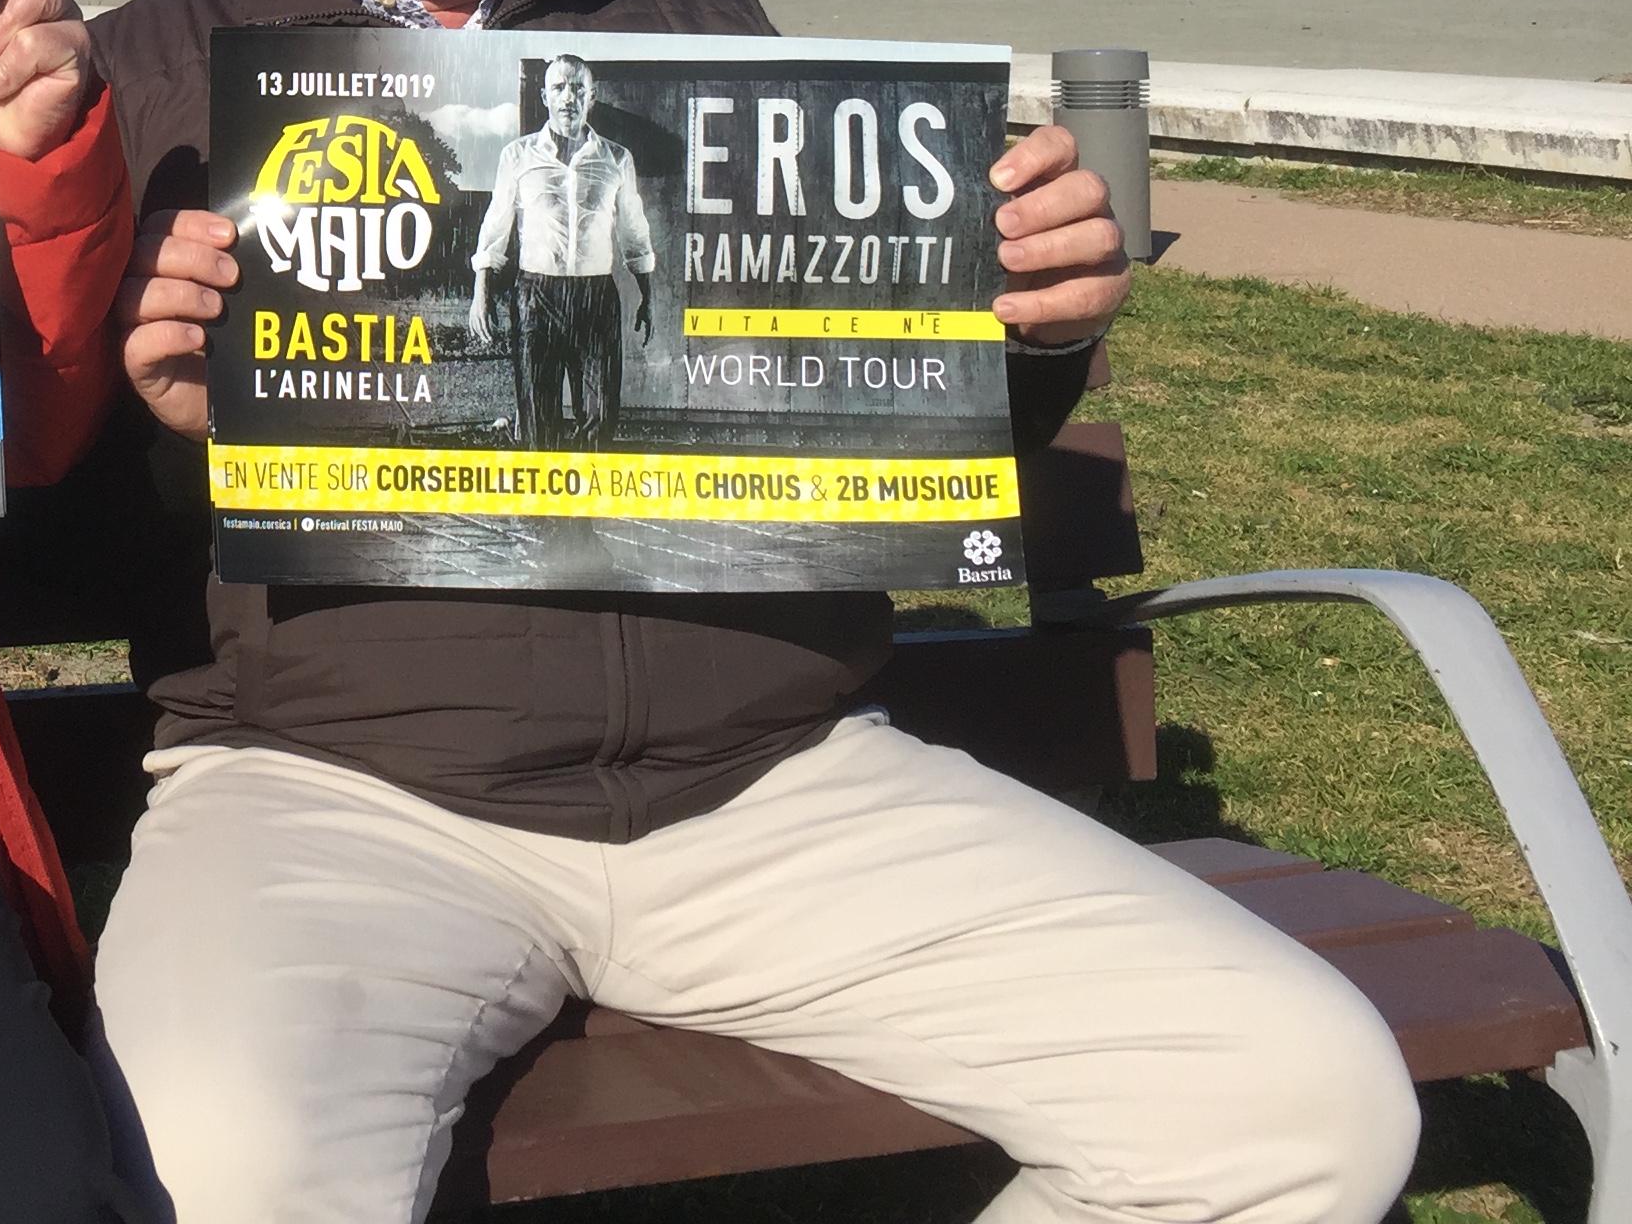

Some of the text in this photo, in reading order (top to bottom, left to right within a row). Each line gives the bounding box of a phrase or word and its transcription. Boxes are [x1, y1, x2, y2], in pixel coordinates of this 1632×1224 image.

[256, 72, 435, 98] 13 JUILLET 2019
[249, 115, 440, 205] FESTA
[686, 97, 955, 220] EROS
[684, 232, 953, 284] RAMAZZOTTI
[254, 310, 432, 365] BASTIA
[690, 315, 779, 333] VITA
[823, 316, 859, 333] CE
[255, 369, 432, 403] L'ARINELLA
[683, 354, 947, 391] WORLD TOUR
[224, 462, 999, 502] EN VENTE SUR CORSEBILLET.CO À BASTIA CHORUS & 2B MUSIQUE
[315, 519, 349, 532] Festival
[351, 519, 378, 532] FESTA
